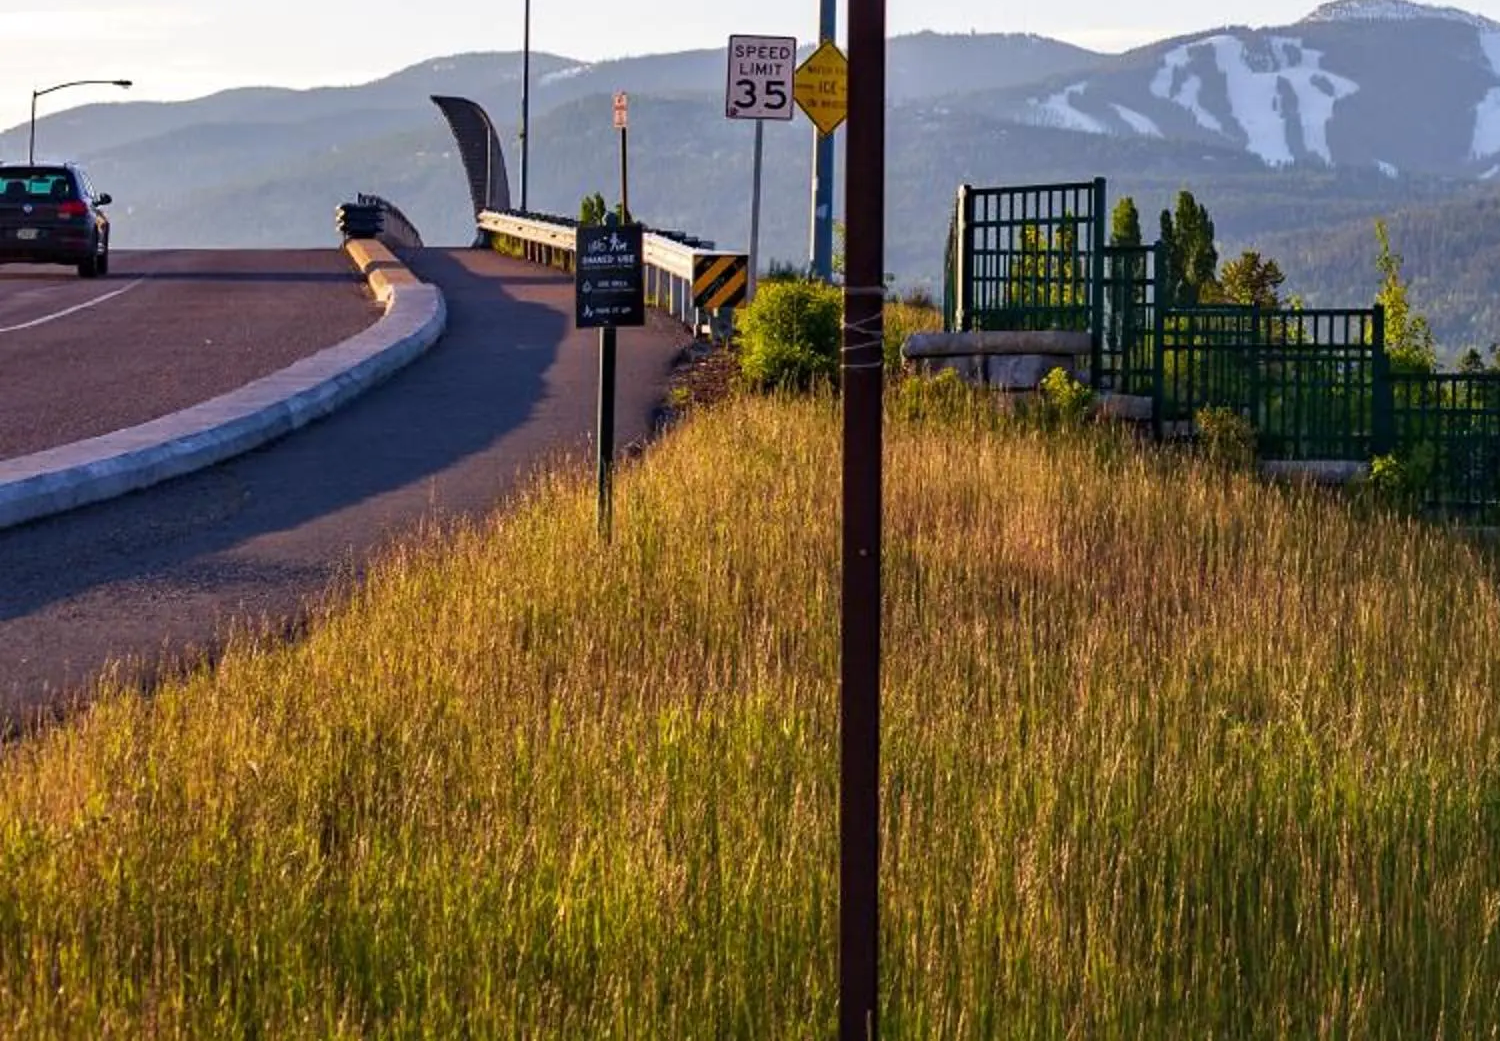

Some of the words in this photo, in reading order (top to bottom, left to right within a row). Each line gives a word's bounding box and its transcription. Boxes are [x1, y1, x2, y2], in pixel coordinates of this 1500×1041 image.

[736, 46, 790, 59] SPEED
[740, 63, 782, 75] LIMIT
[734, 80, 787, 109] 35
[818, 80, 837, 95] ICE
